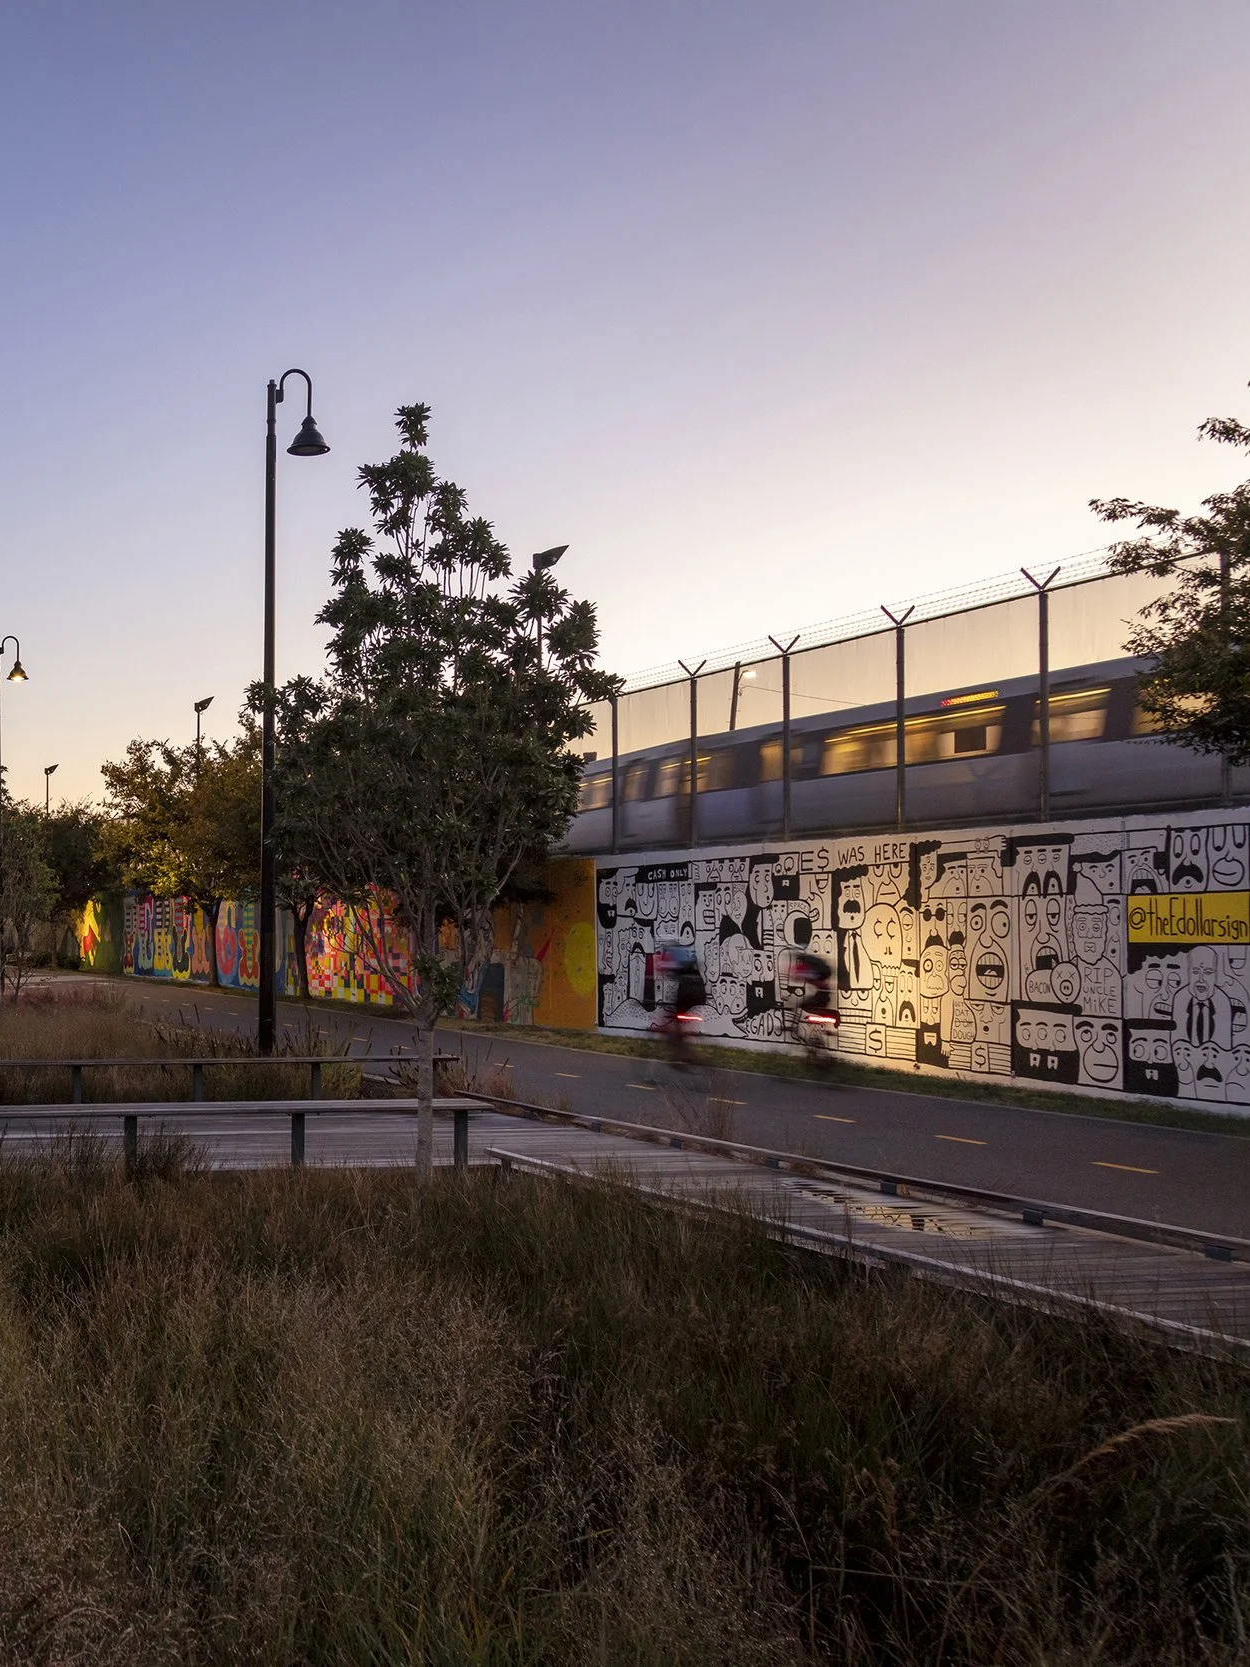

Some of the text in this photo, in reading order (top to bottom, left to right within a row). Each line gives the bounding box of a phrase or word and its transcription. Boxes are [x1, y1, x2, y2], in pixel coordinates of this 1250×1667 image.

[837, 845, 865, 866] WAS
[874, 842, 907, 863] HERE
[647, 868, 688, 881] CASH ONLY
[1129, 896, 1249, 941] @theEdollarsign
[1083, 966, 1114, 984] RIP
[1029, 980, 1051, 995] BACON
[1082, 985, 1117, 998] UNCLE
[954, 1008, 969, 1017] DAT
[952, 1028, 974, 1040] DOUGH
